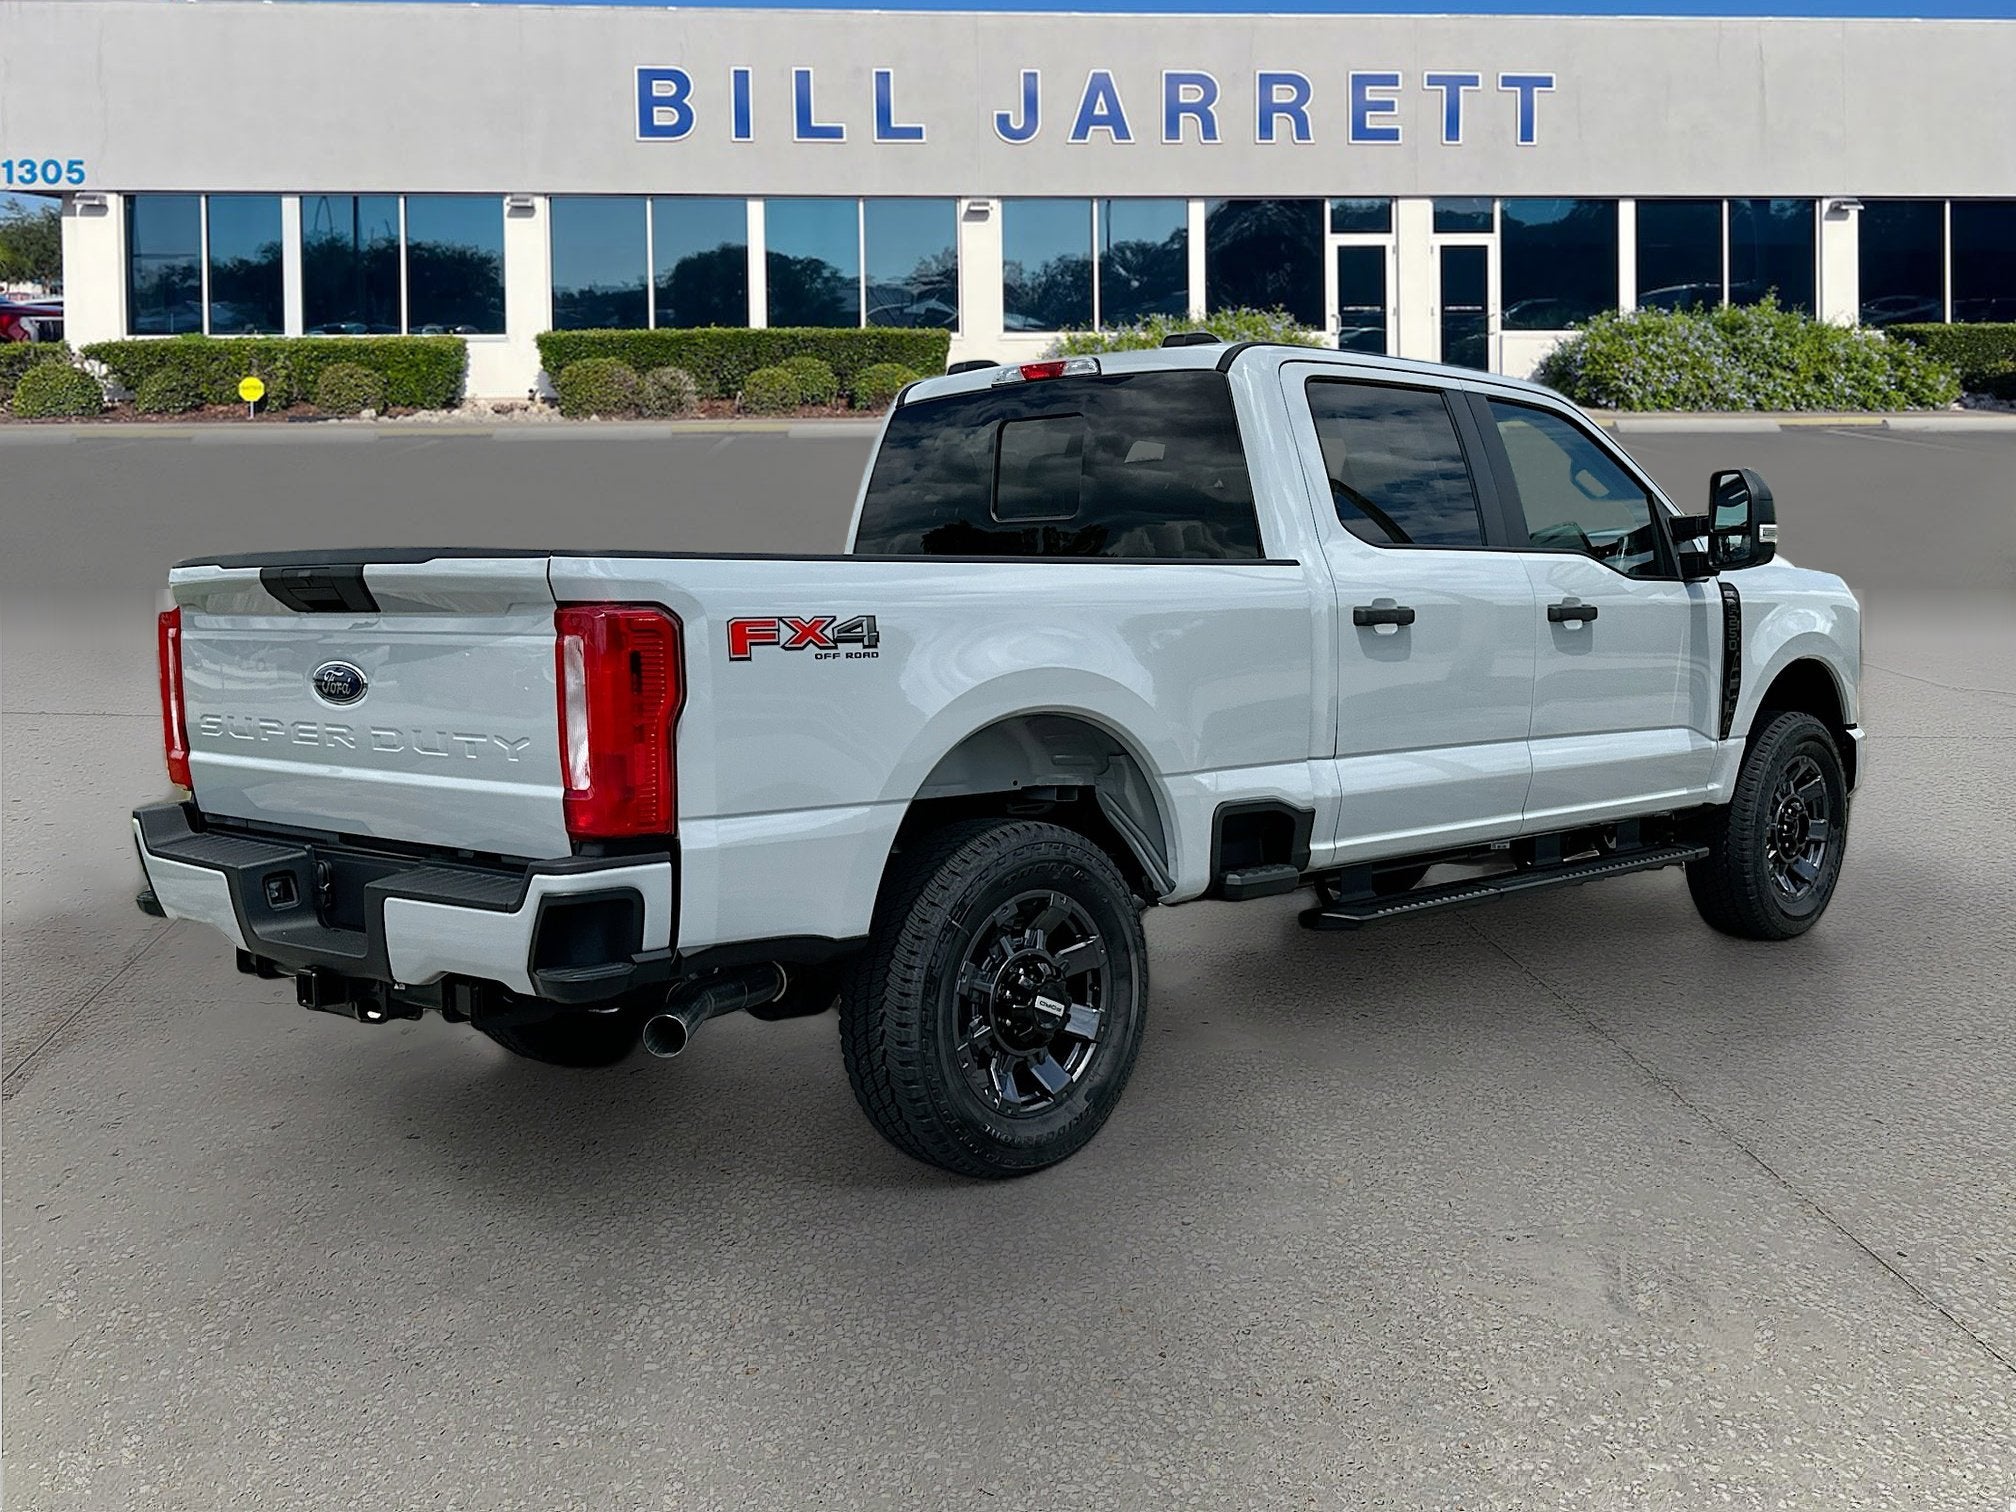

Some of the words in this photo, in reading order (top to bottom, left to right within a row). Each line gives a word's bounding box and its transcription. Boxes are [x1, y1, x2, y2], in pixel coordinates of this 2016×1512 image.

[633, 64, 927, 145] BILL
[991, 67, 1557, 146] JARRETT
[1, 158, 86, 185] 1305
[726, 615, 880, 662] FX4
[814, 652, 841, 660] OFF
[845, 651, 879, 659] ROAD
[200, 713, 356, 750] SUPER
[370, 725, 531, 763] DUTY
